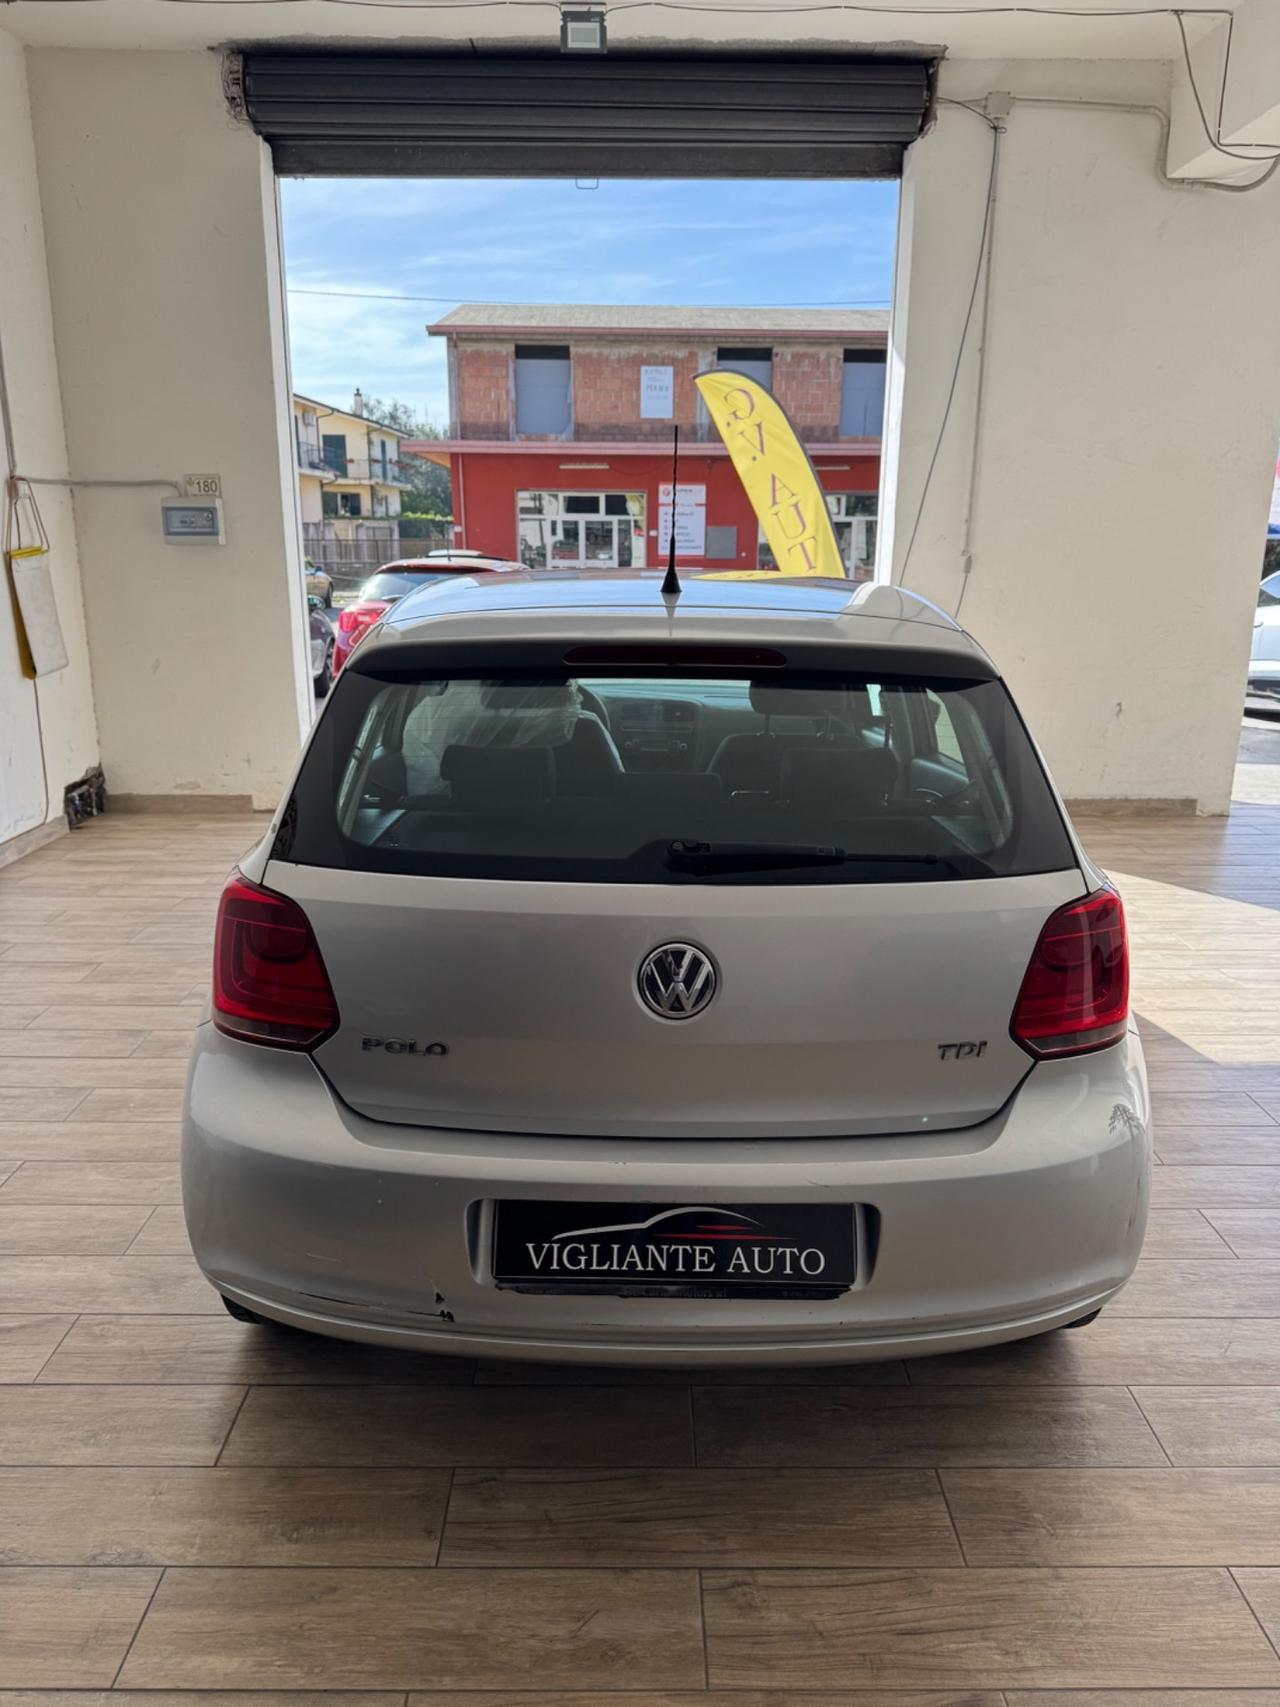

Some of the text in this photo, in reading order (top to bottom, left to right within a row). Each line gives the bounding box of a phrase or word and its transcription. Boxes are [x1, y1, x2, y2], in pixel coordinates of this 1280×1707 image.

[361, 1037, 448, 1056] POLO
[937, 1040, 988, 1060] TDI
[526, 1243, 826, 1275] VIGLIANTE AUTO
